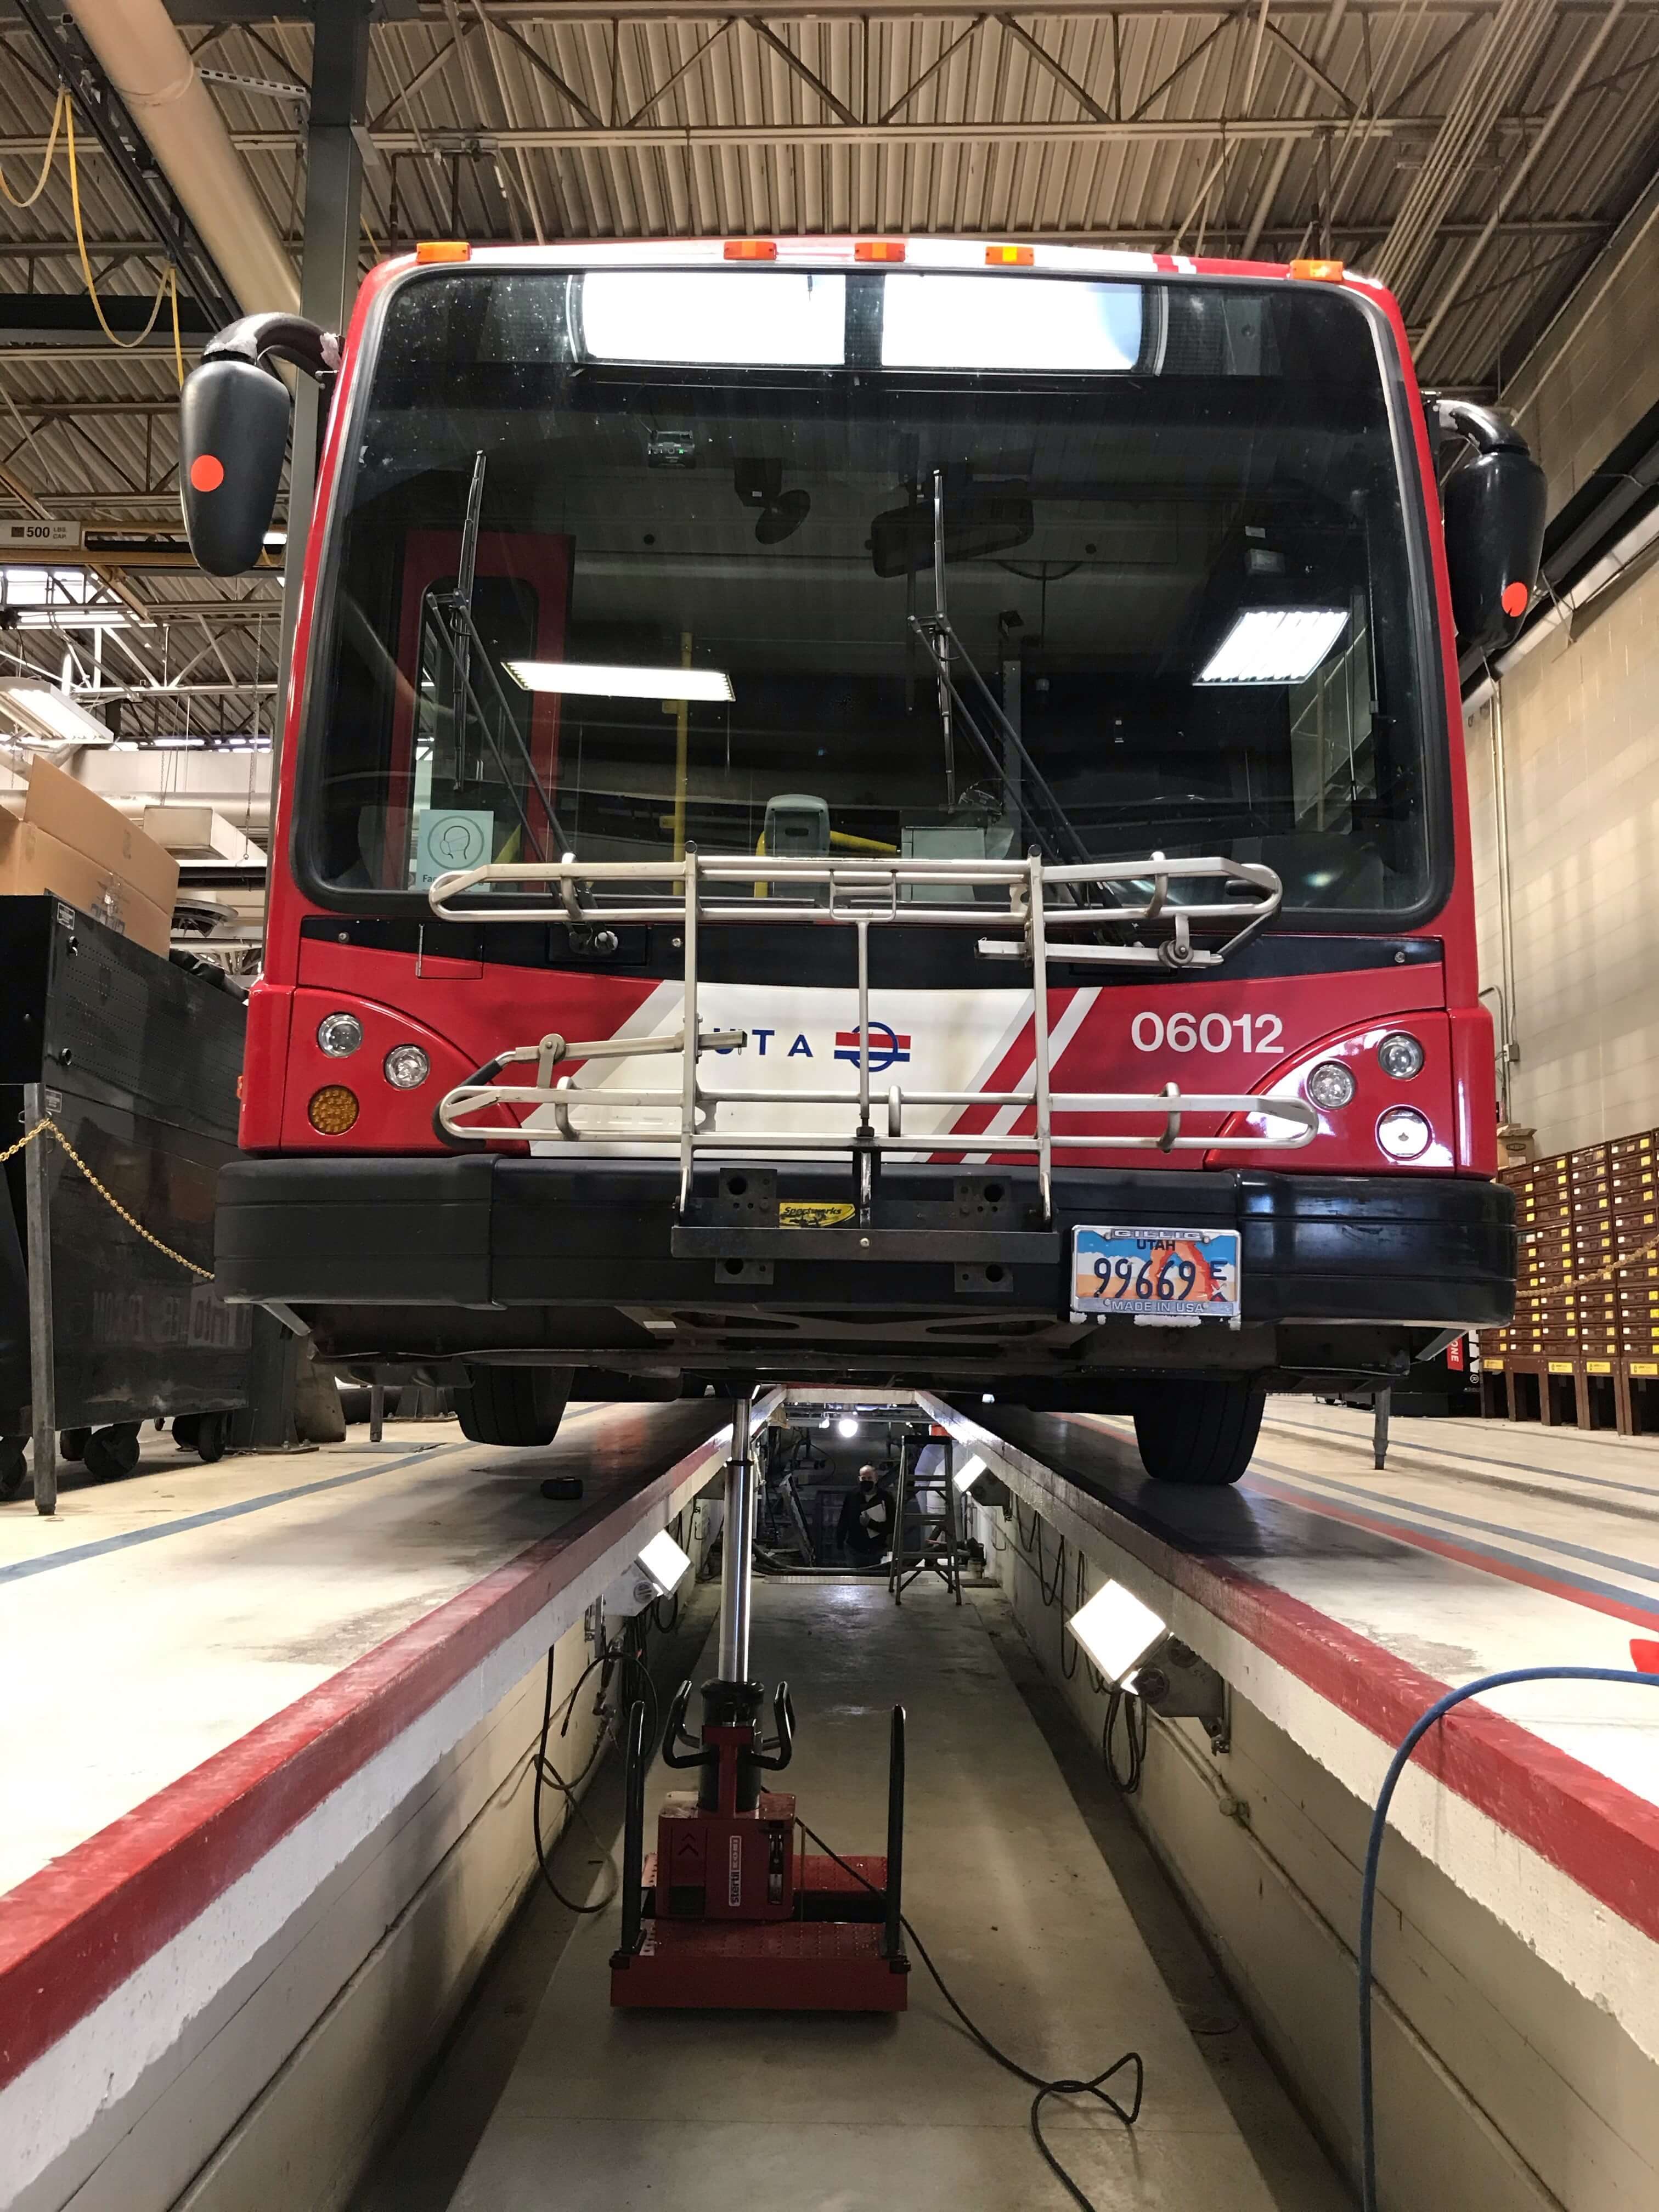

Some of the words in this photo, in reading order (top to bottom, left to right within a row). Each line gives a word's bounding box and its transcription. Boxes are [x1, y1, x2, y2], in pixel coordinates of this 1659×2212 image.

[26, 526, 50, 538] 500
[1131, 1012, 1284, 1053] 06012
[1114, 1230, 1200, 1239] GILLIG
[1136, 1239, 1176, 1251] UTAH
[1094, 1257, 1196, 1301] 99669
[1111, 1301, 1152, 1311] MADE
[1157, 1302, 1170, 1312] IN
[1176, 1302, 1204, 1313] USA
